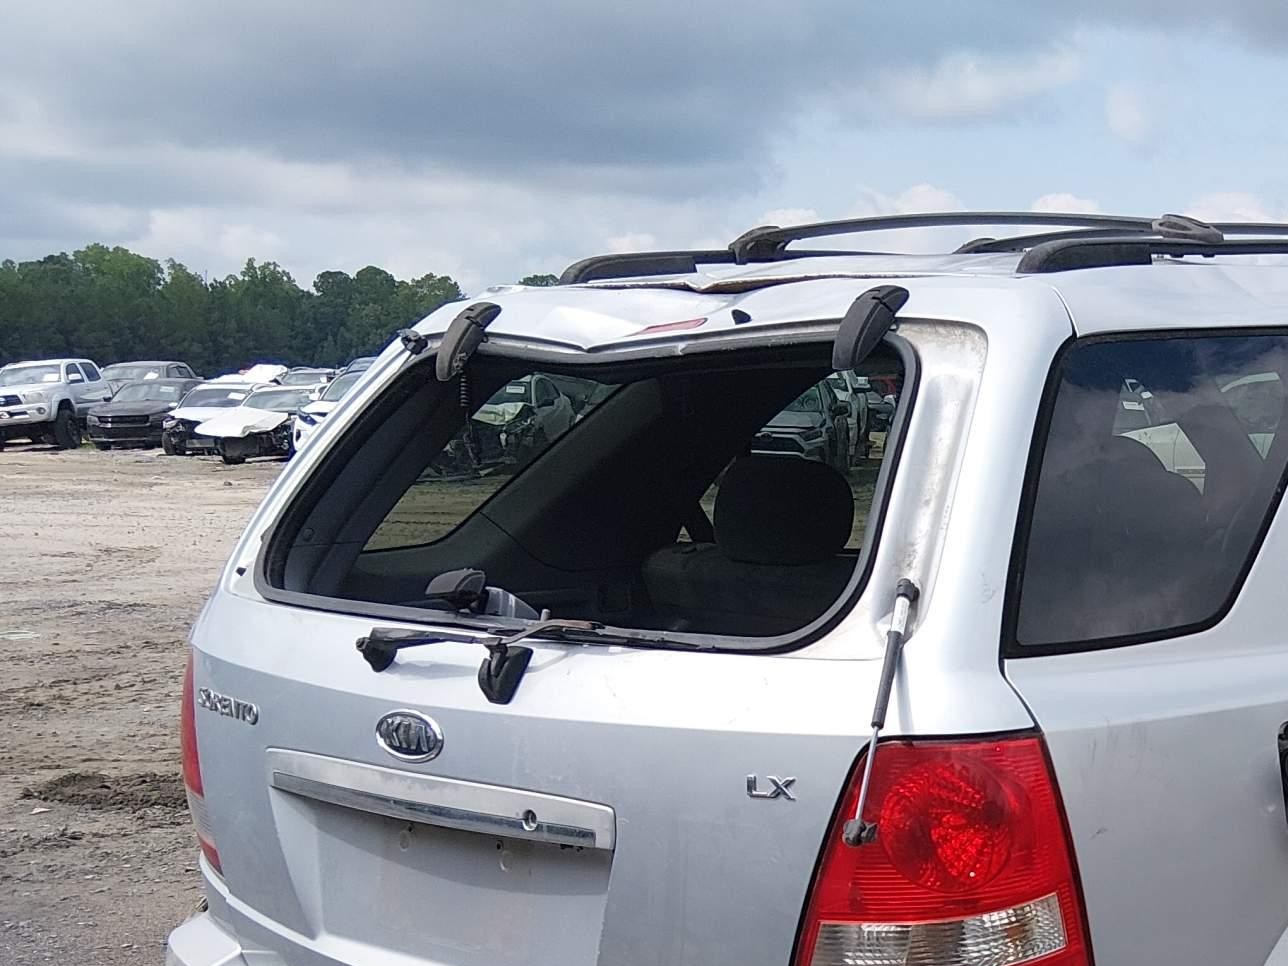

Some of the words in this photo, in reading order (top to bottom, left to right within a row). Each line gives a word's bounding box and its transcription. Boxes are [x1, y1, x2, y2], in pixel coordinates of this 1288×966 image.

[198, 686, 259, 726] SORENTO
[380, 717, 435, 753] KIA
[746, 774, 797, 801] LX
